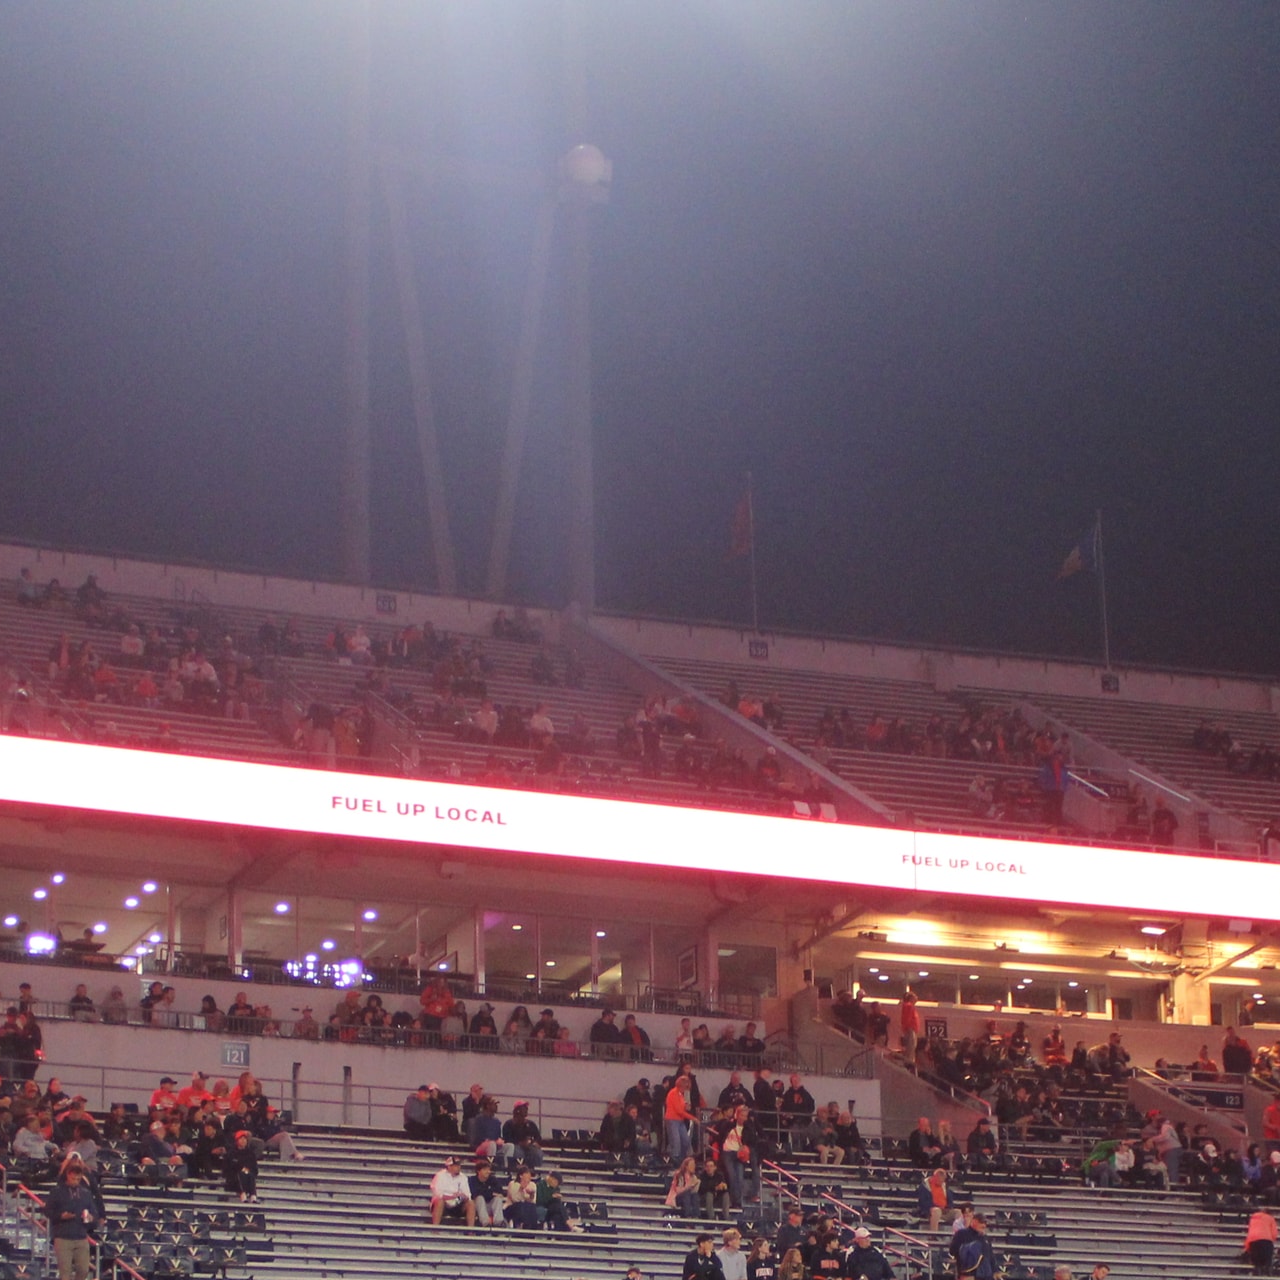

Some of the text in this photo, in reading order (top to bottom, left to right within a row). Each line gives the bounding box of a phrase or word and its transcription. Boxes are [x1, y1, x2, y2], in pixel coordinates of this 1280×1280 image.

[332, 796, 507, 825] FUEL UP LOCAL
[902, 854, 1027, 875] FUEL UP LOCAL
[226, 1049, 245, 1064] 121
